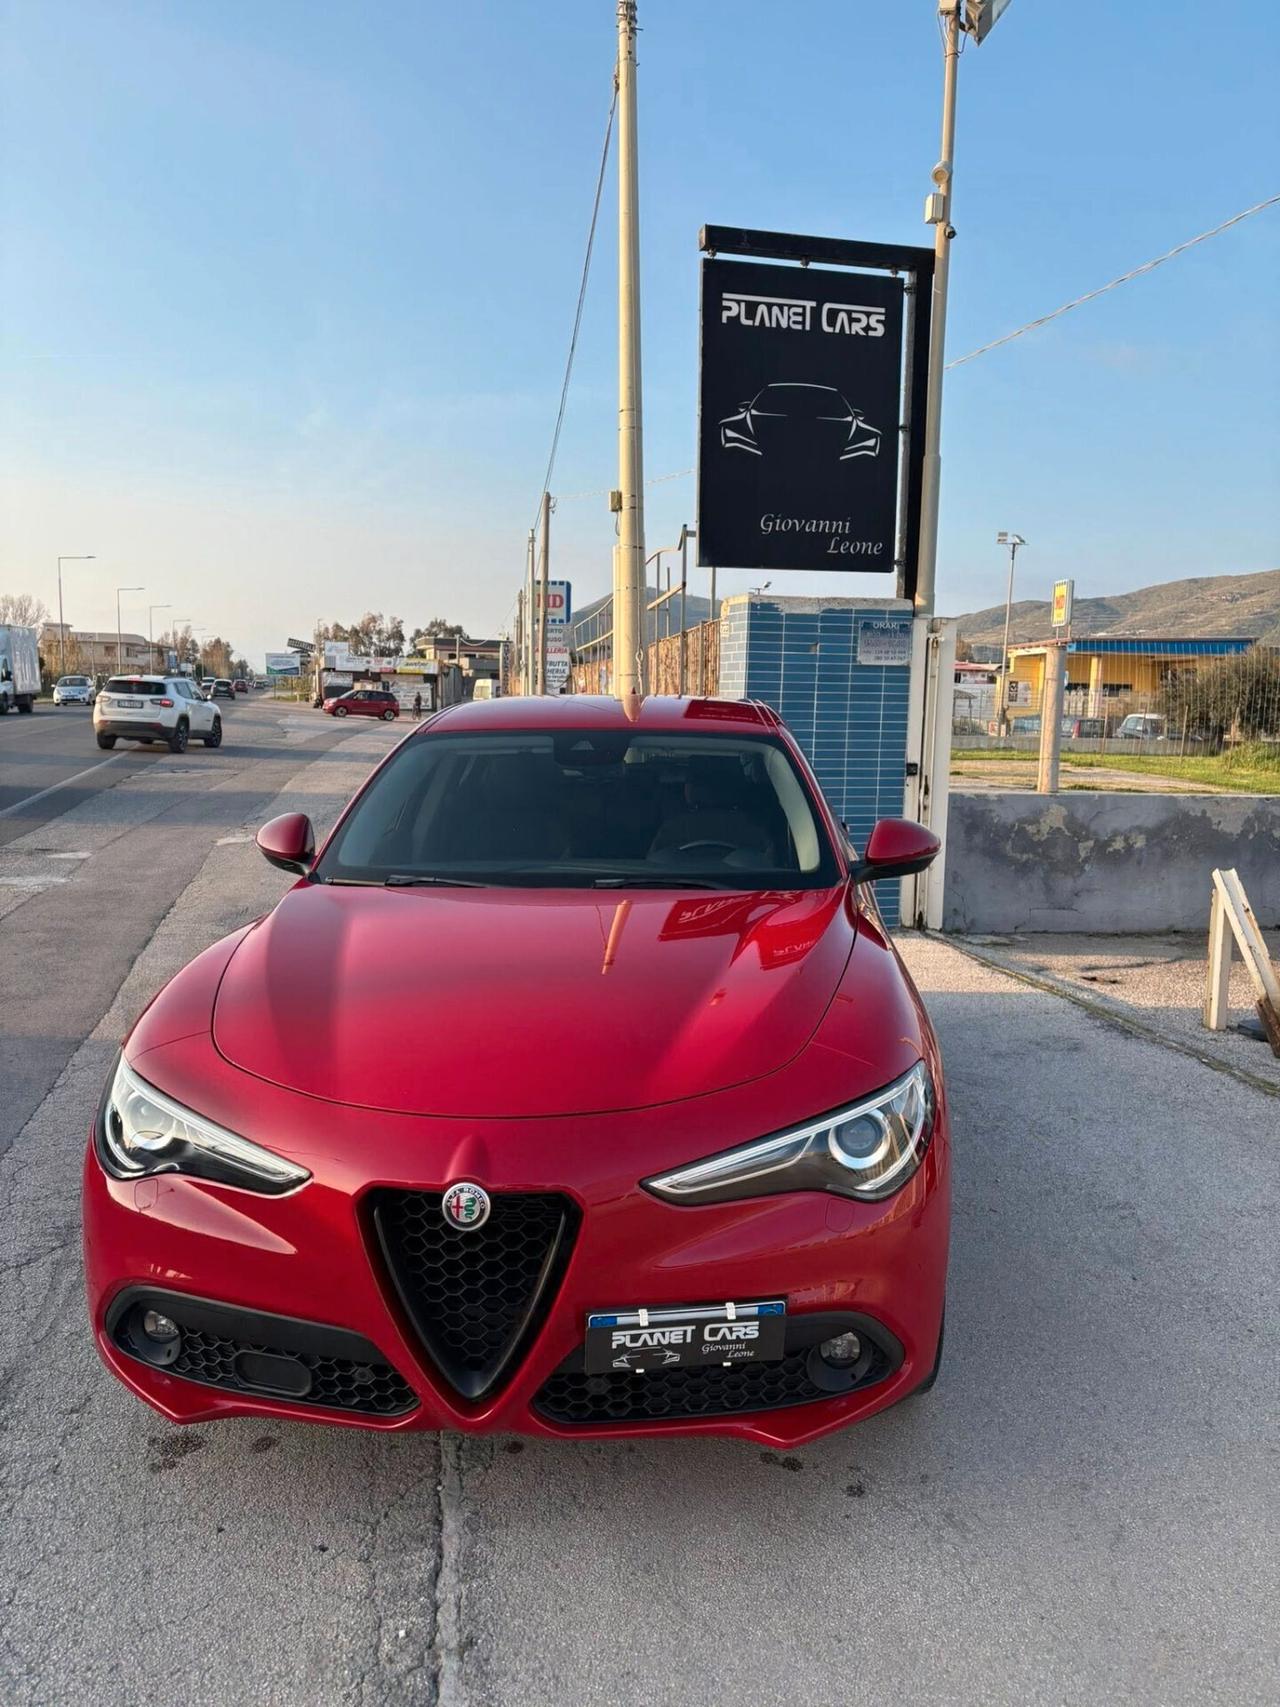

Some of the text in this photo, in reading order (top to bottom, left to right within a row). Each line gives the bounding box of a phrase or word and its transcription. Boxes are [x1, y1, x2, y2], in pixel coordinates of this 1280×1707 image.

[721, 292, 886, 337] PLANET CARS
[760, 513, 851, 534] Giovanni
[827, 536, 883, 556] Leone
[612, 1321, 760, 1349] PLANET CARS
[701, 1342, 746, 1354] Giovanni
[727, 1349, 756, 1359] Leone
